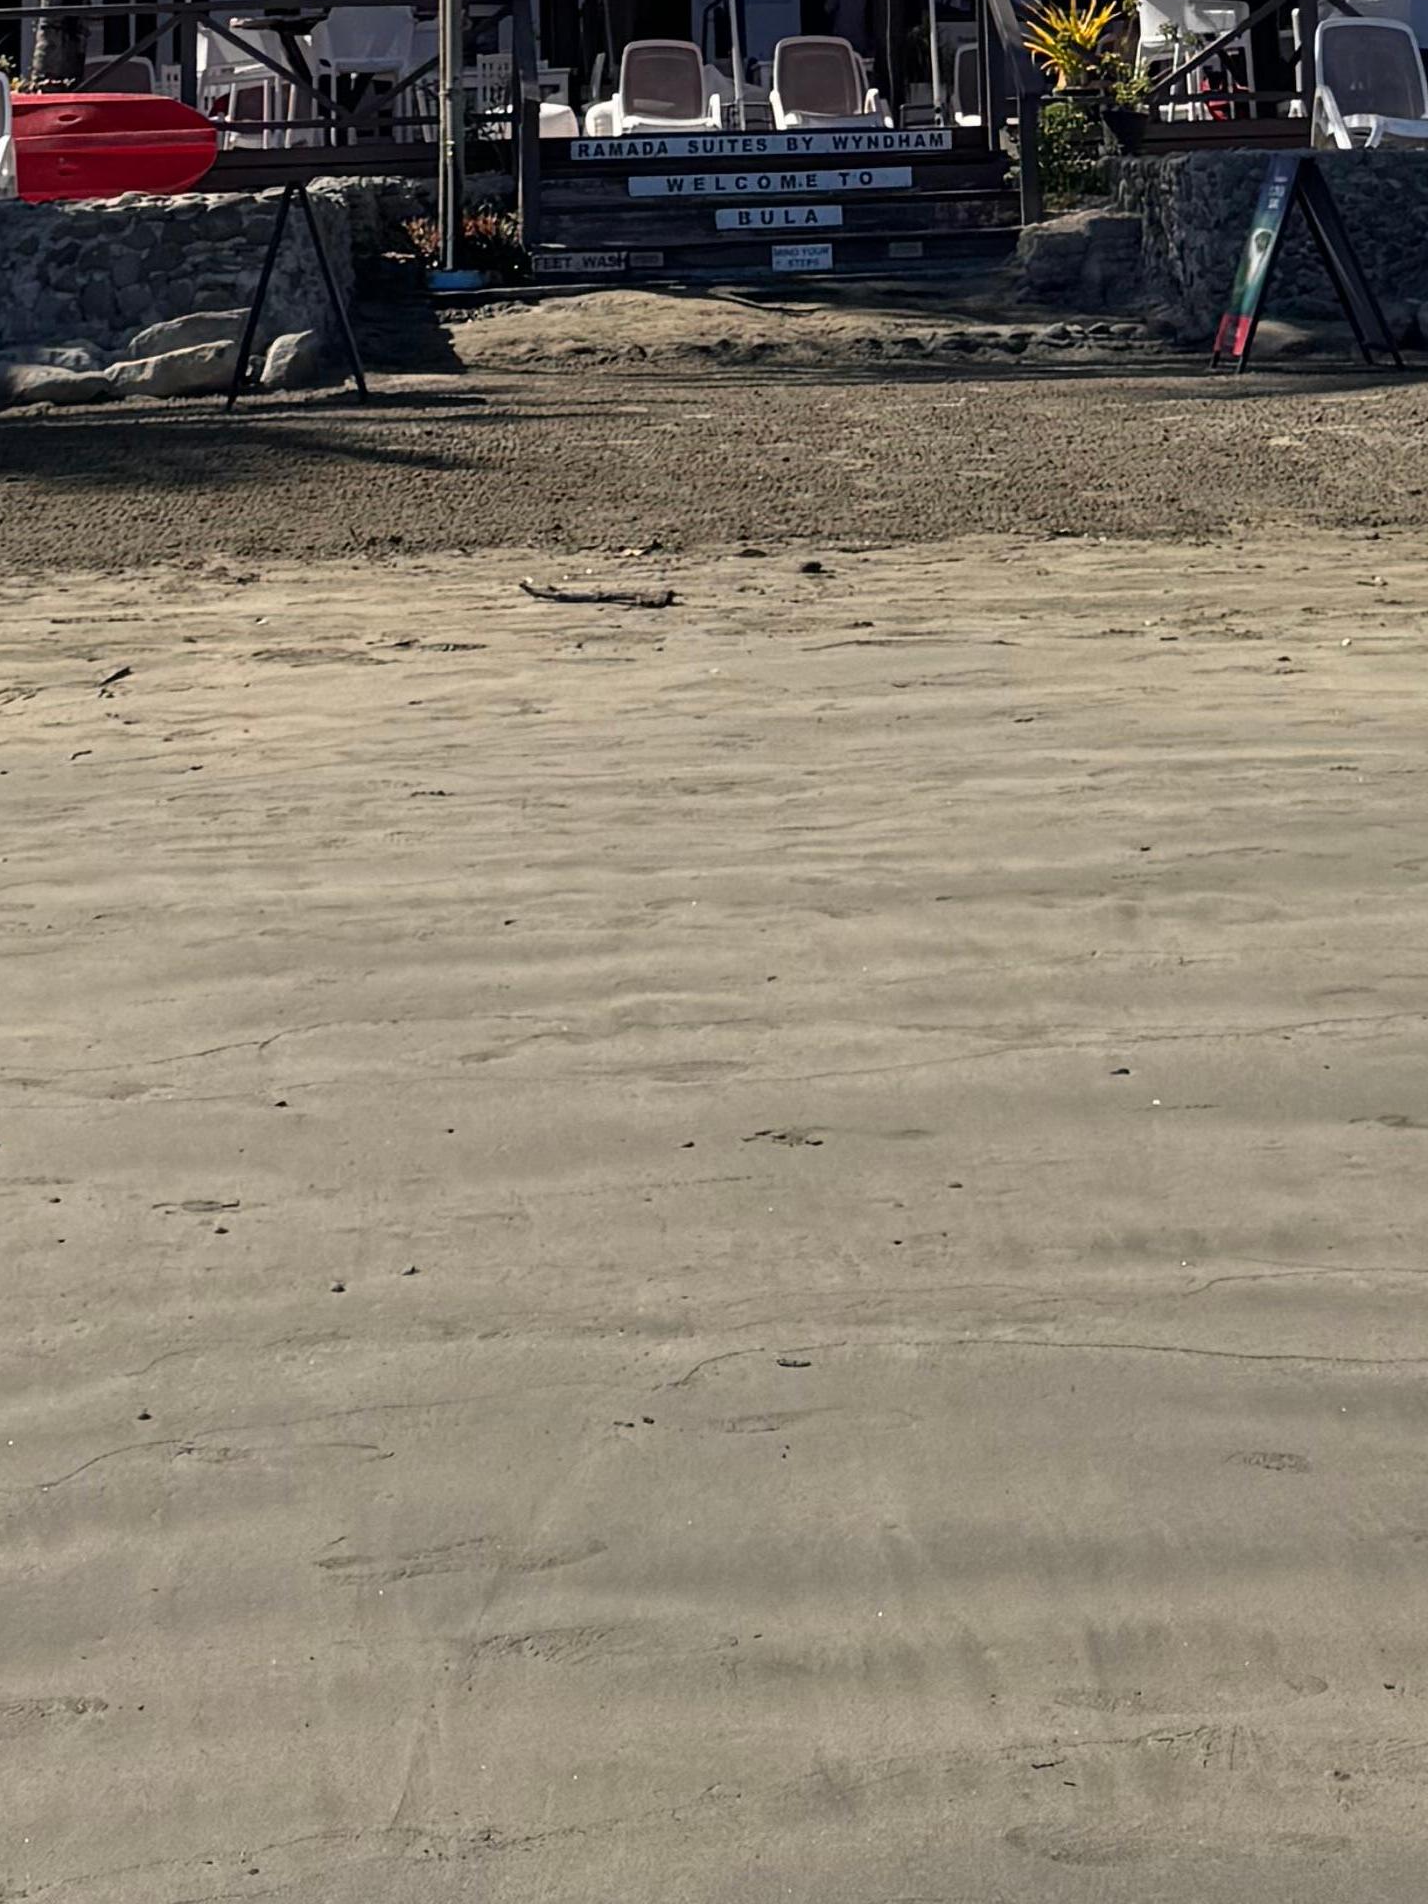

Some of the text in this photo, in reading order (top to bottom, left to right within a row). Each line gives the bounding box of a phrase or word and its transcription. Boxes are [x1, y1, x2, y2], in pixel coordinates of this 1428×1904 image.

[578, 133, 944, 157] RAMADA SUITES BY WYNDHAM
[666, 171, 873, 192] WELCOME TO
[738, 209, 818, 225] BULA
[534, 257, 572, 270] FEET
